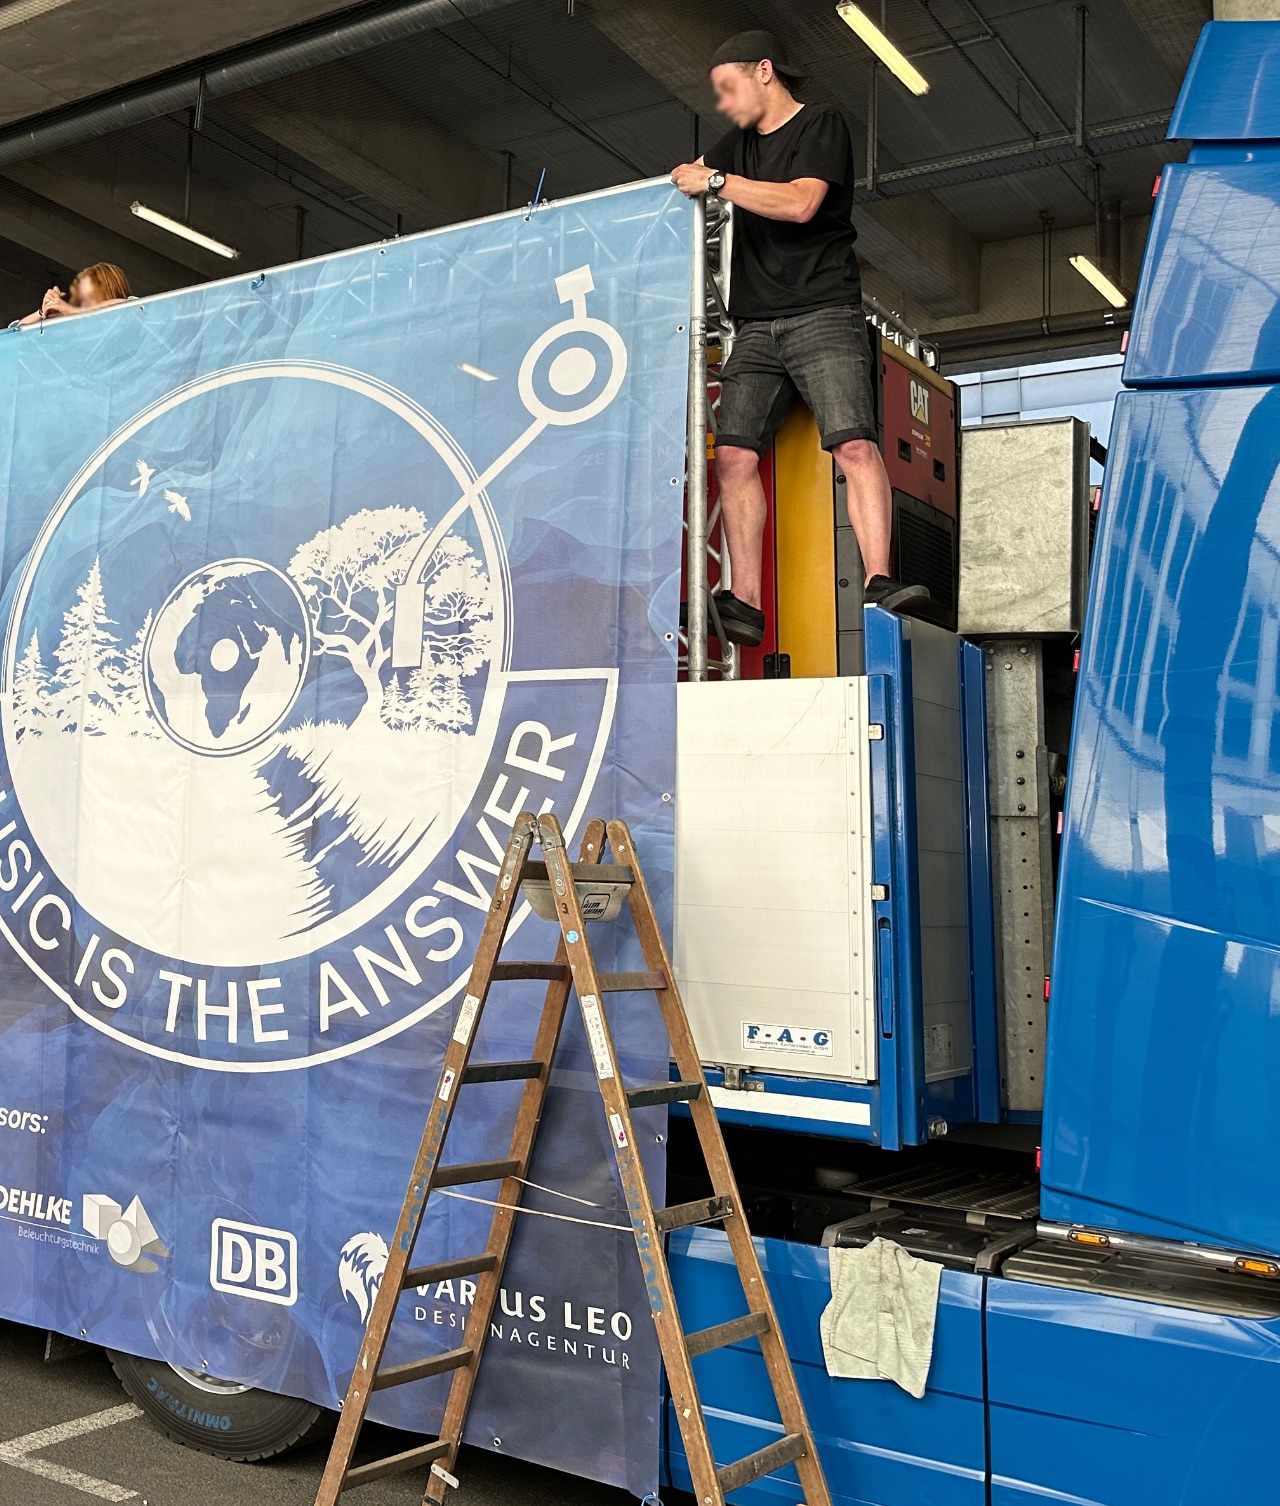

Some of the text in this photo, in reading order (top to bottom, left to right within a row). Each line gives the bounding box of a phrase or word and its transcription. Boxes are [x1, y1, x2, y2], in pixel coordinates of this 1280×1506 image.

[910, 380, 929, 426] CAT
[74, 935, 135, 1008] IS
[159, 969, 290, 1044] THE
[320, 720, 578, 1033] ANSWER
[17, 1225, 100, 1255] Beleuchtungstechnik
[221, 1231, 287, 1291] DB
[415, 1306, 630, 1370] DESINAGENTUR
[416, 1278, 632, 1341] VARUS LEO
[146, 1376, 232, 1431] OMNITRAC
